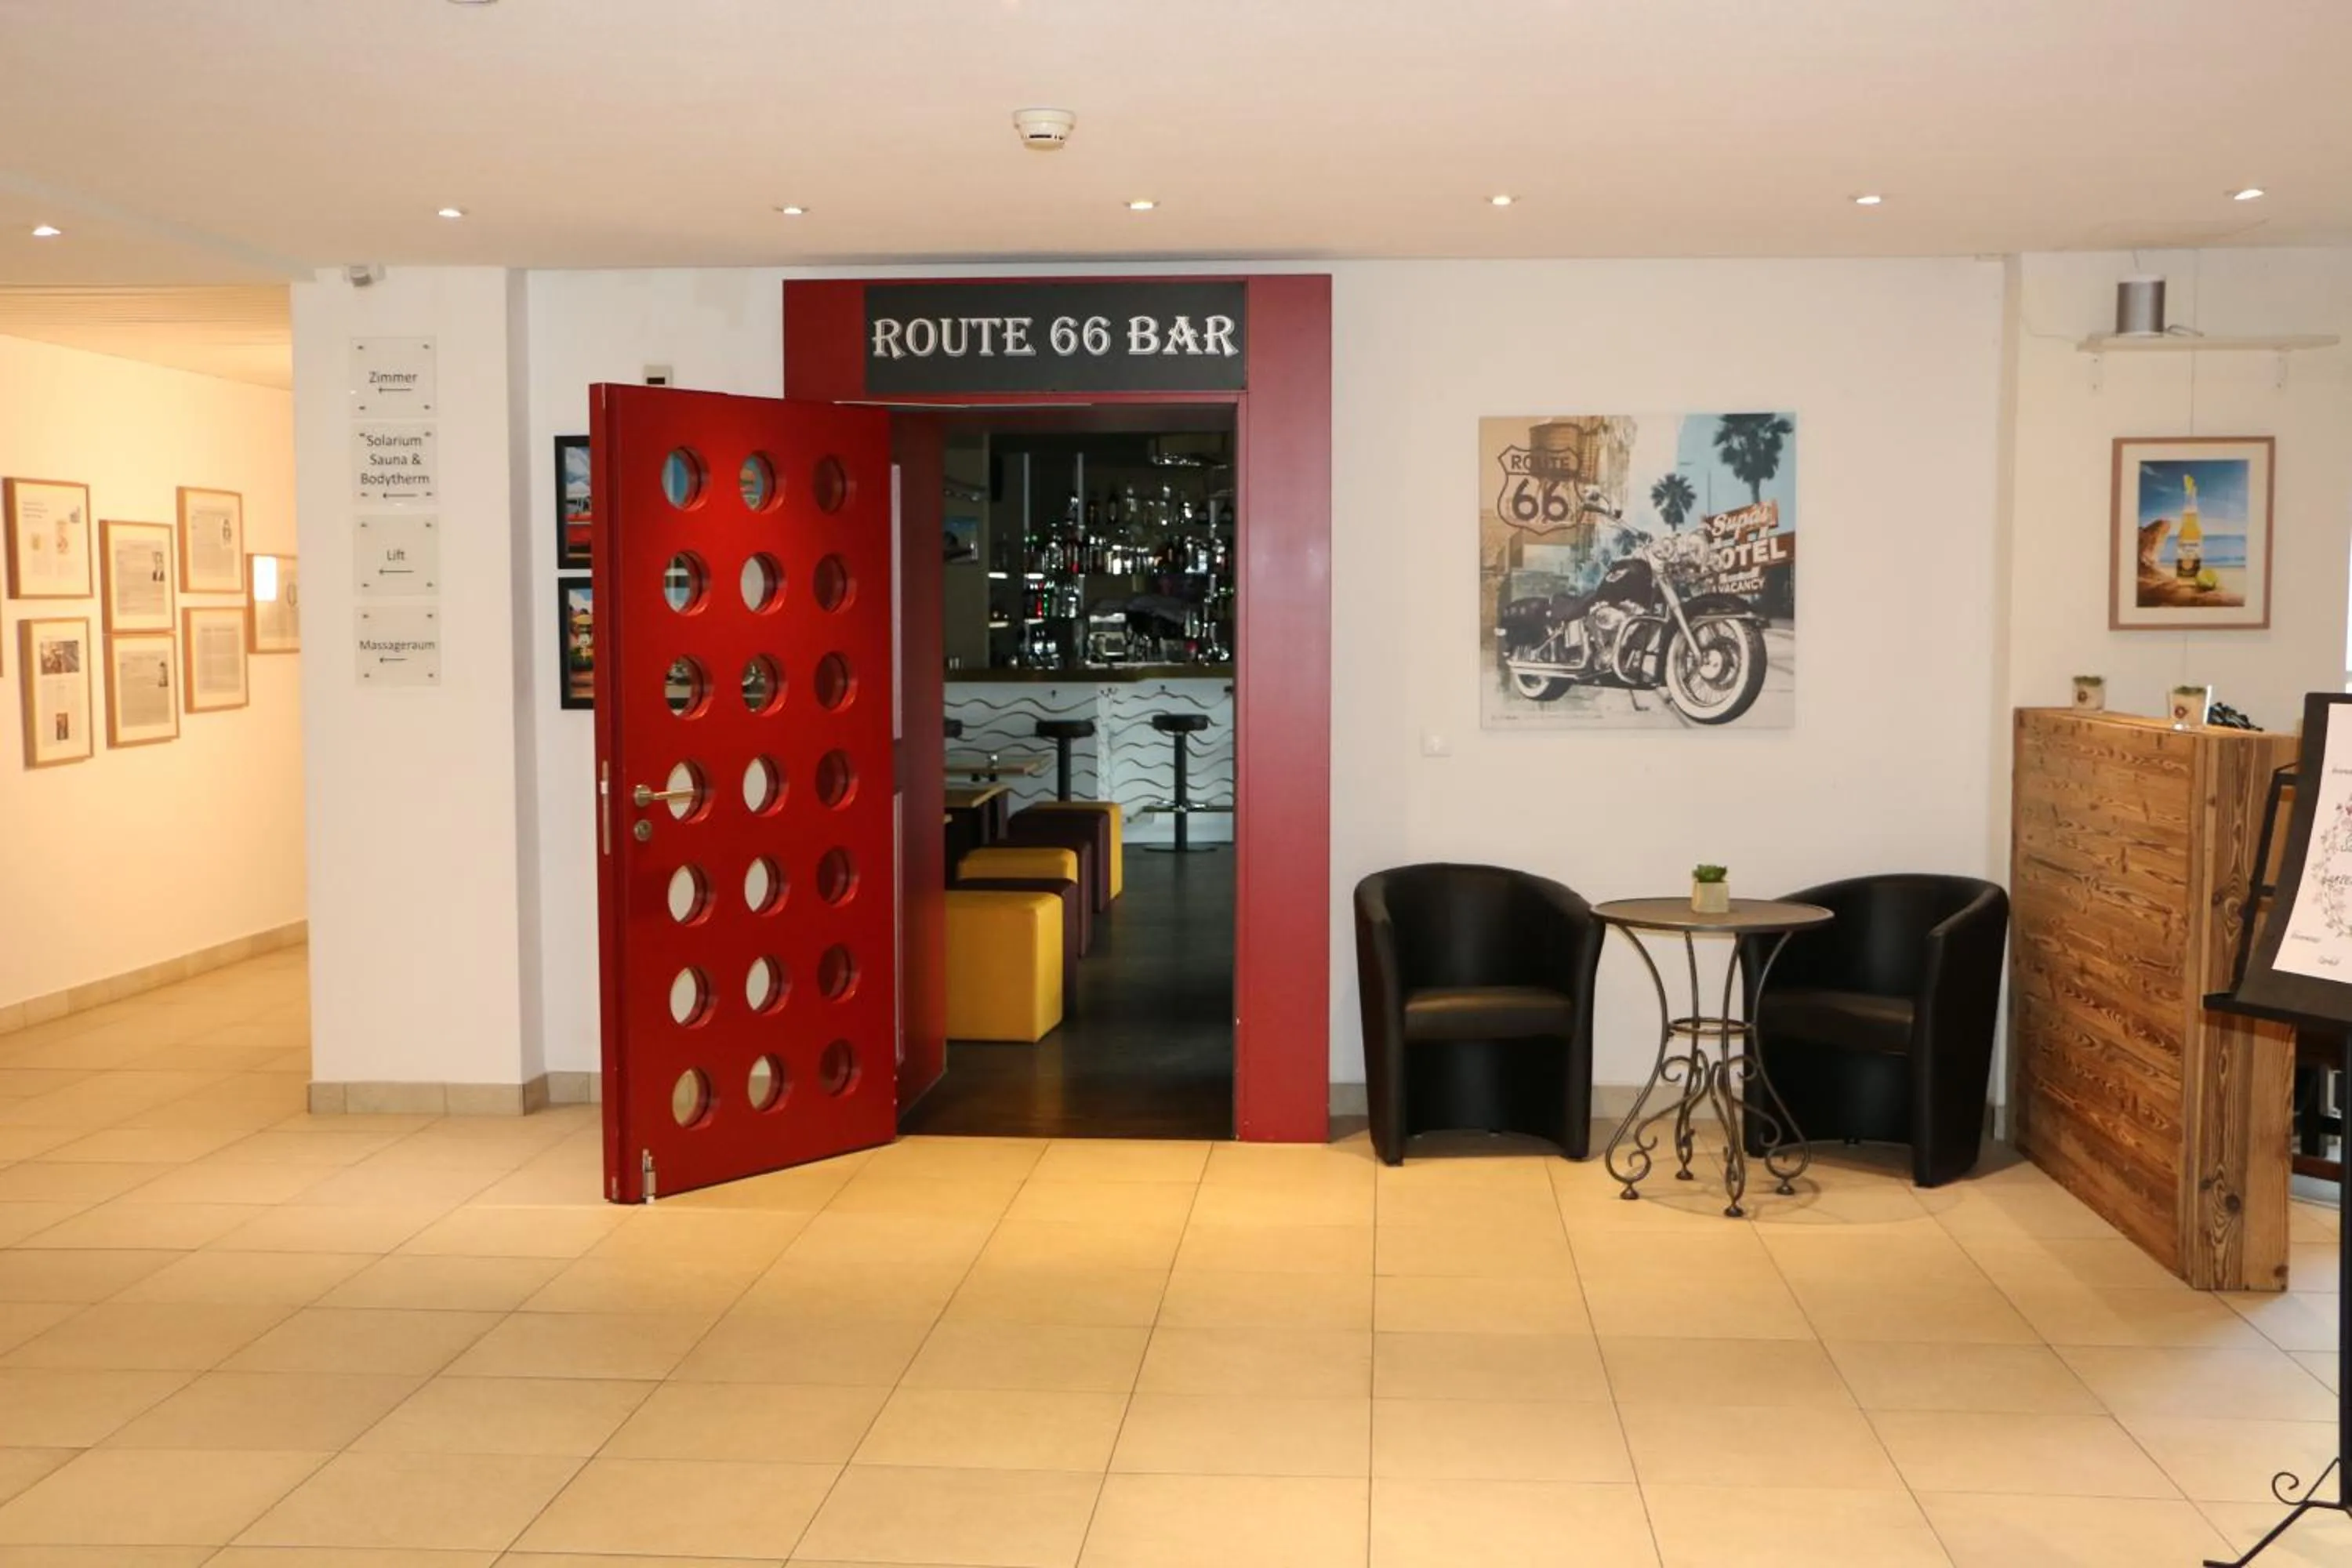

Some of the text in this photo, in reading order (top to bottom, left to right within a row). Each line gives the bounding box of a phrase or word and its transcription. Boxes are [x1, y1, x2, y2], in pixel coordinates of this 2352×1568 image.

[872, 315, 1239, 359] ROUTE 66 BAR
[368, 370, 419, 383] Zimmer
[366, 434, 422, 447] Solarium
[369, 453, 422, 465] Sauna &
[361, 472, 430, 486] Bodytherm
[1512, 477, 1569, 521] 66
[387, 550, 405, 561] Lift
[1717, 537, 1787, 571] OTEL
[360, 640, 435, 652] Massageraum
